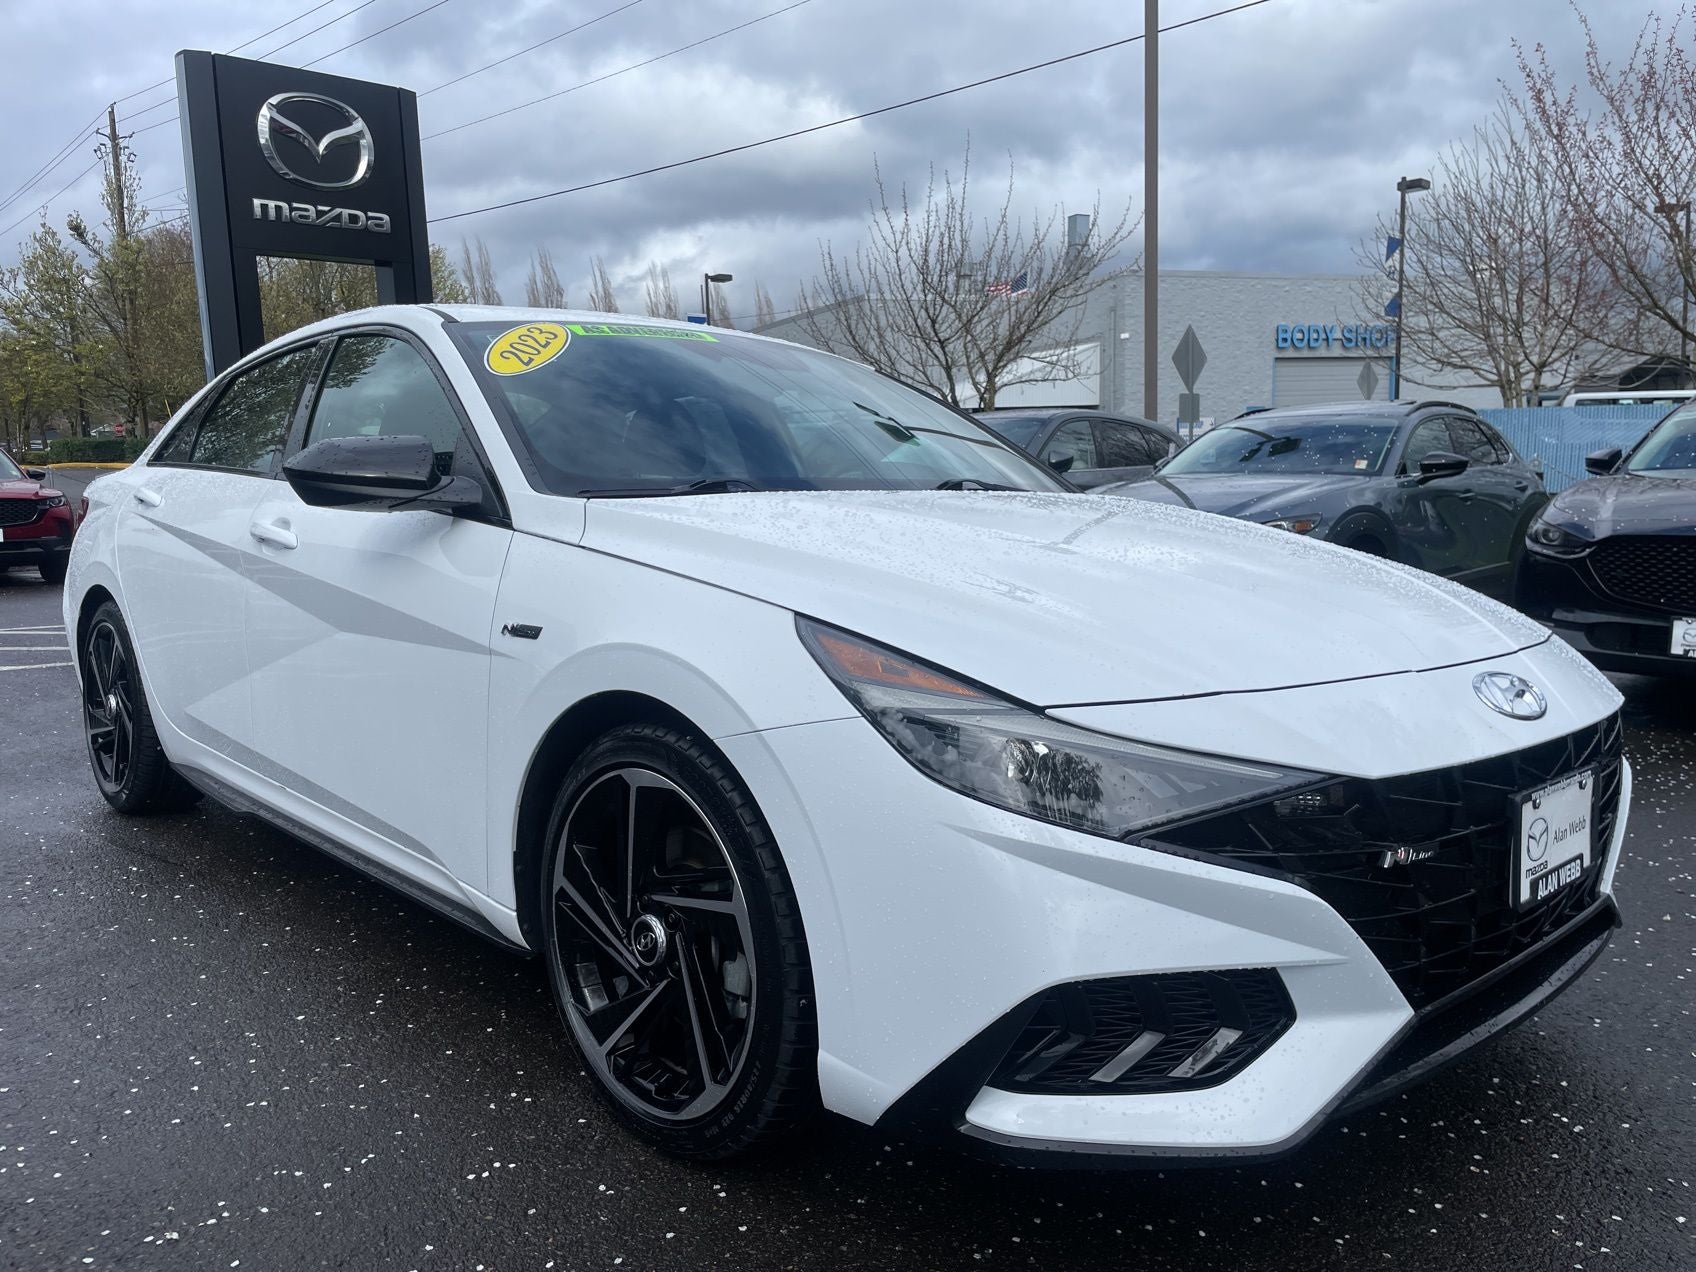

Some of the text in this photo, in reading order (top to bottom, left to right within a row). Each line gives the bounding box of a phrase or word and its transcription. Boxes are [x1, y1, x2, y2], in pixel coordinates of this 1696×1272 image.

[499, 326, 558, 367] 2023
[1277, 323, 1397, 349] BODY SHOP
[1553, 816, 1586, 844] Alan Webb
[1537, 859, 1581, 900] ALAN WEBB
